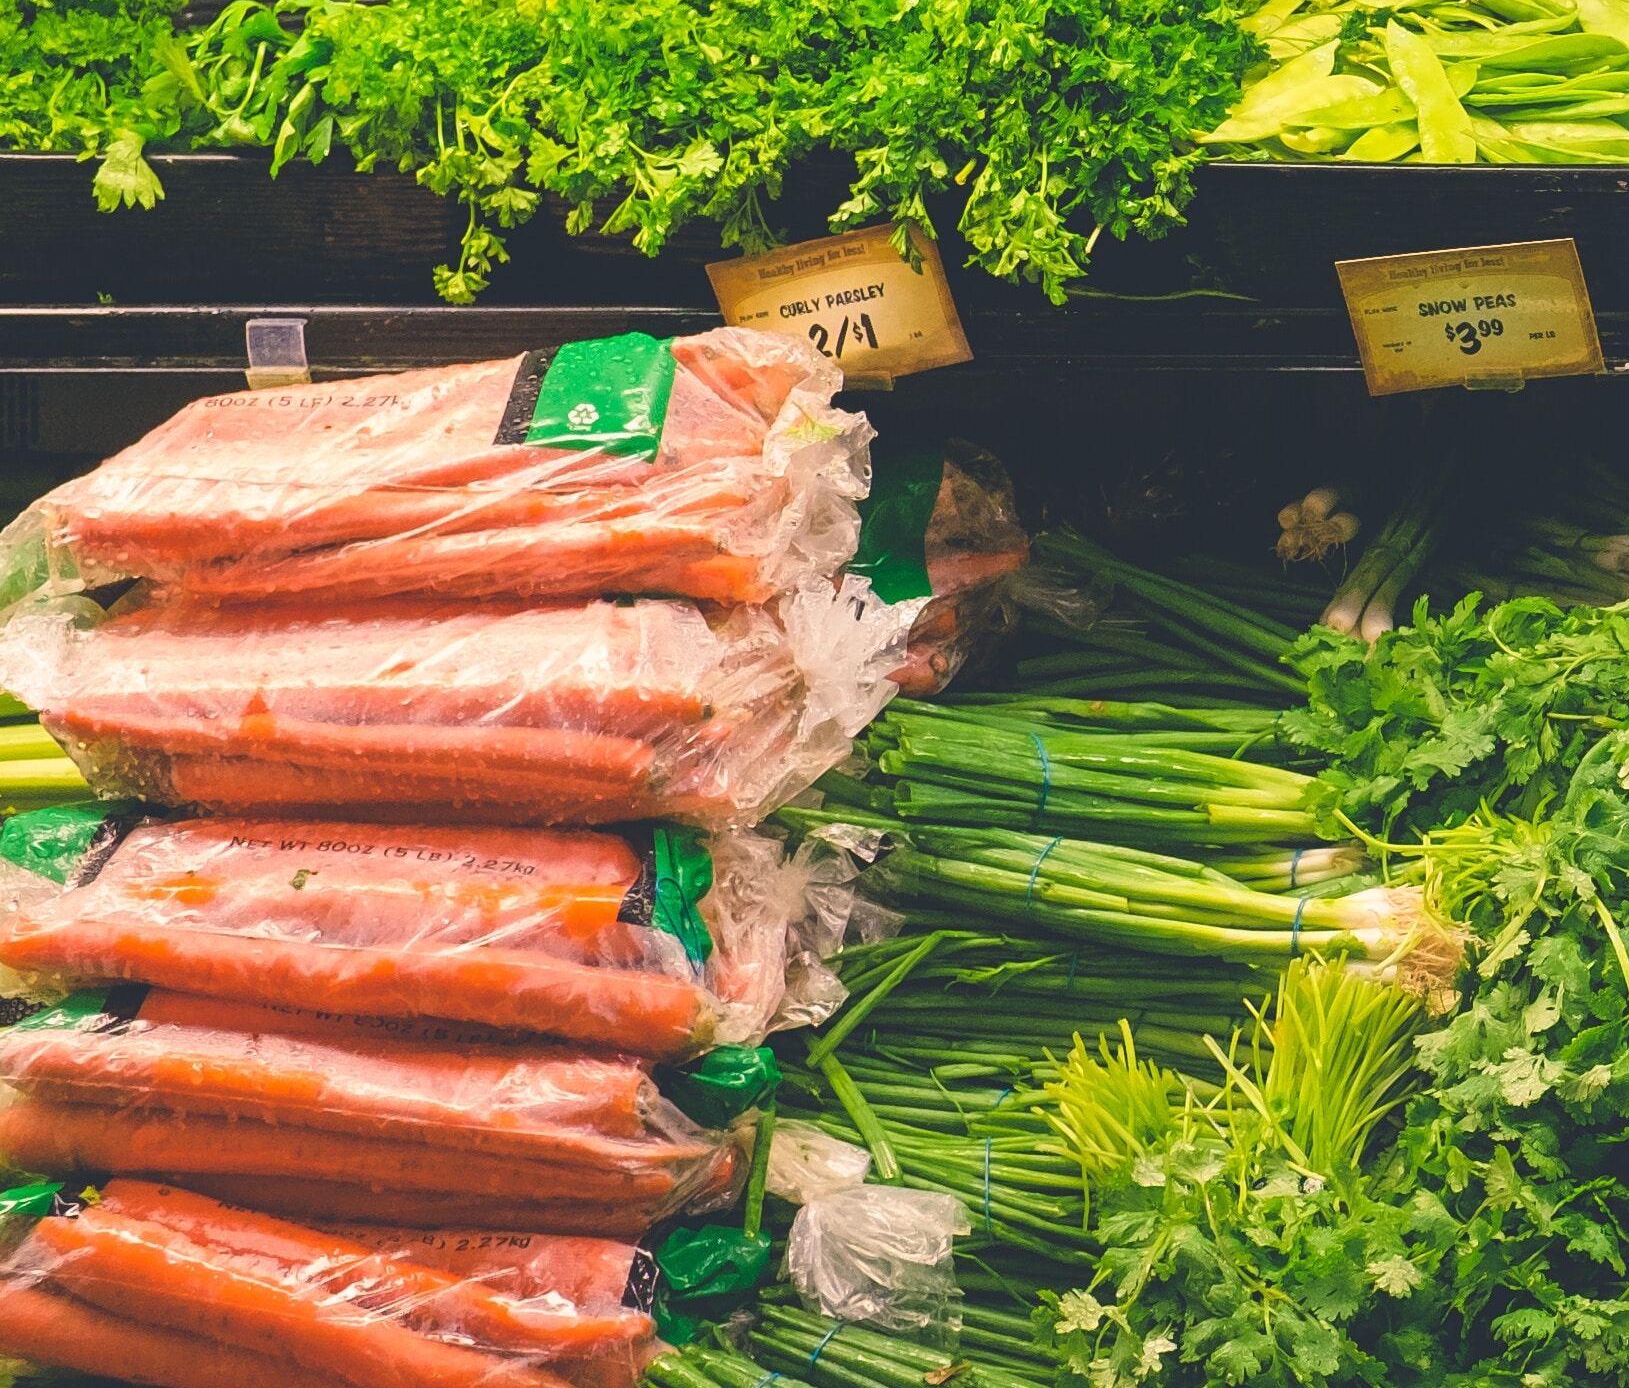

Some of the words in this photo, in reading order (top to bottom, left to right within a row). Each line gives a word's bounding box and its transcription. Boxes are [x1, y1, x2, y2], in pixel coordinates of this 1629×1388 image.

[780, 297, 821, 318] CURLY
[826, 283, 885, 307] PARSLEY
[1418, 299, 1467, 317] SNOW
[1473, 293, 1517, 309] PEAS
[230, 836, 269, 849] NET
[280, 840, 310, 851] WT
